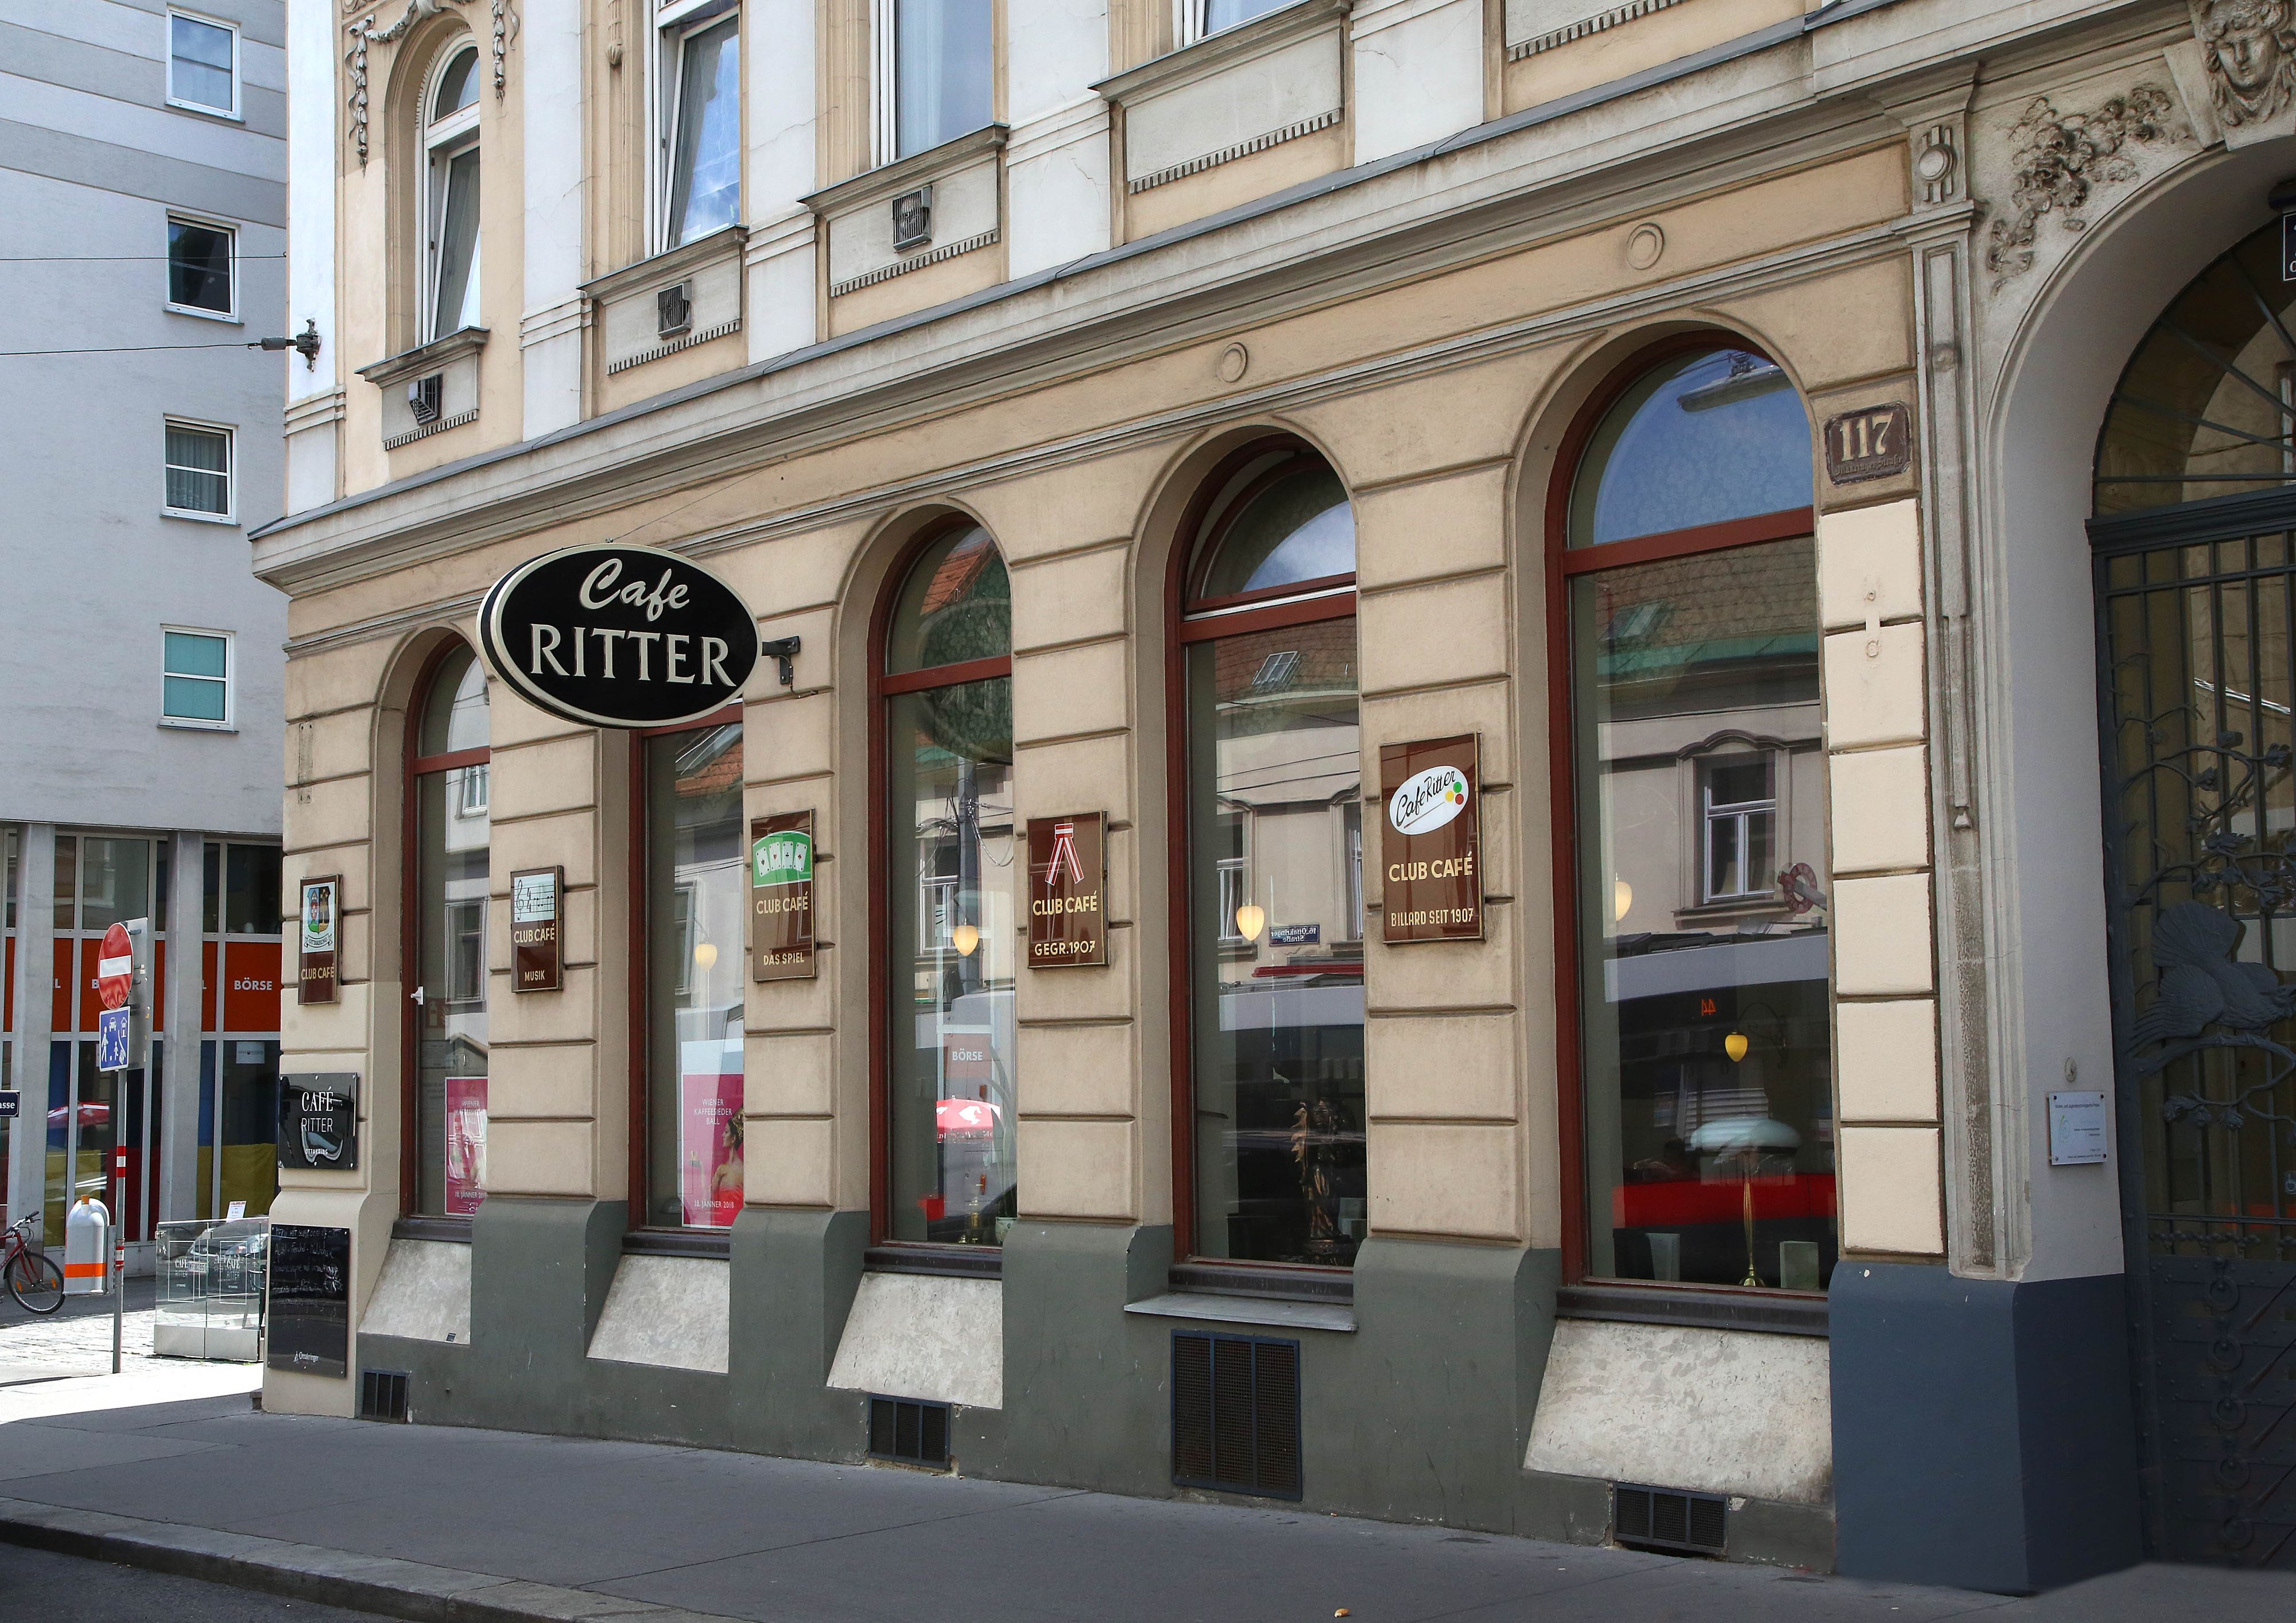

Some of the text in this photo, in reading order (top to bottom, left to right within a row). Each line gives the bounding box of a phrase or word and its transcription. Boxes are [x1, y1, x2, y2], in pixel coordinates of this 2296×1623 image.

[1840, 412, 1894, 462] 117
[579, 558, 690, 622] Cafe
[530, 623, 737, 687] RITTER
[1389, 851, 1473, 882] CLUB CAFÉ
[757, 891, 808, 915] CLUB CAFÉ
[1033, 890, 1097, 916] CLUB CAFÉ
[1391, 907, 1473, 927] BILLARD SEIT 1907
[514, 924, 555, 943] CLUB CAFÉ
[763, 952, 804, 966] DAS SPIEL
[301, 963, 334, 980] CLUB CAFÉ
[525, 970, 545, 982] MUSIK
[234, 977, 273, 990] BÖRSE
[952, 1048, 983, 1061] BÖRSE
[301, 1086, 333, 1111] CAFÉ
[301, 1118, 333, 1132] RITTER
[460, 1190, 478, 1199] JÄNNER
[701, 1199, 722, 1208] JÄNNER
[175, 1257, 188, 1268] CAFÉ
